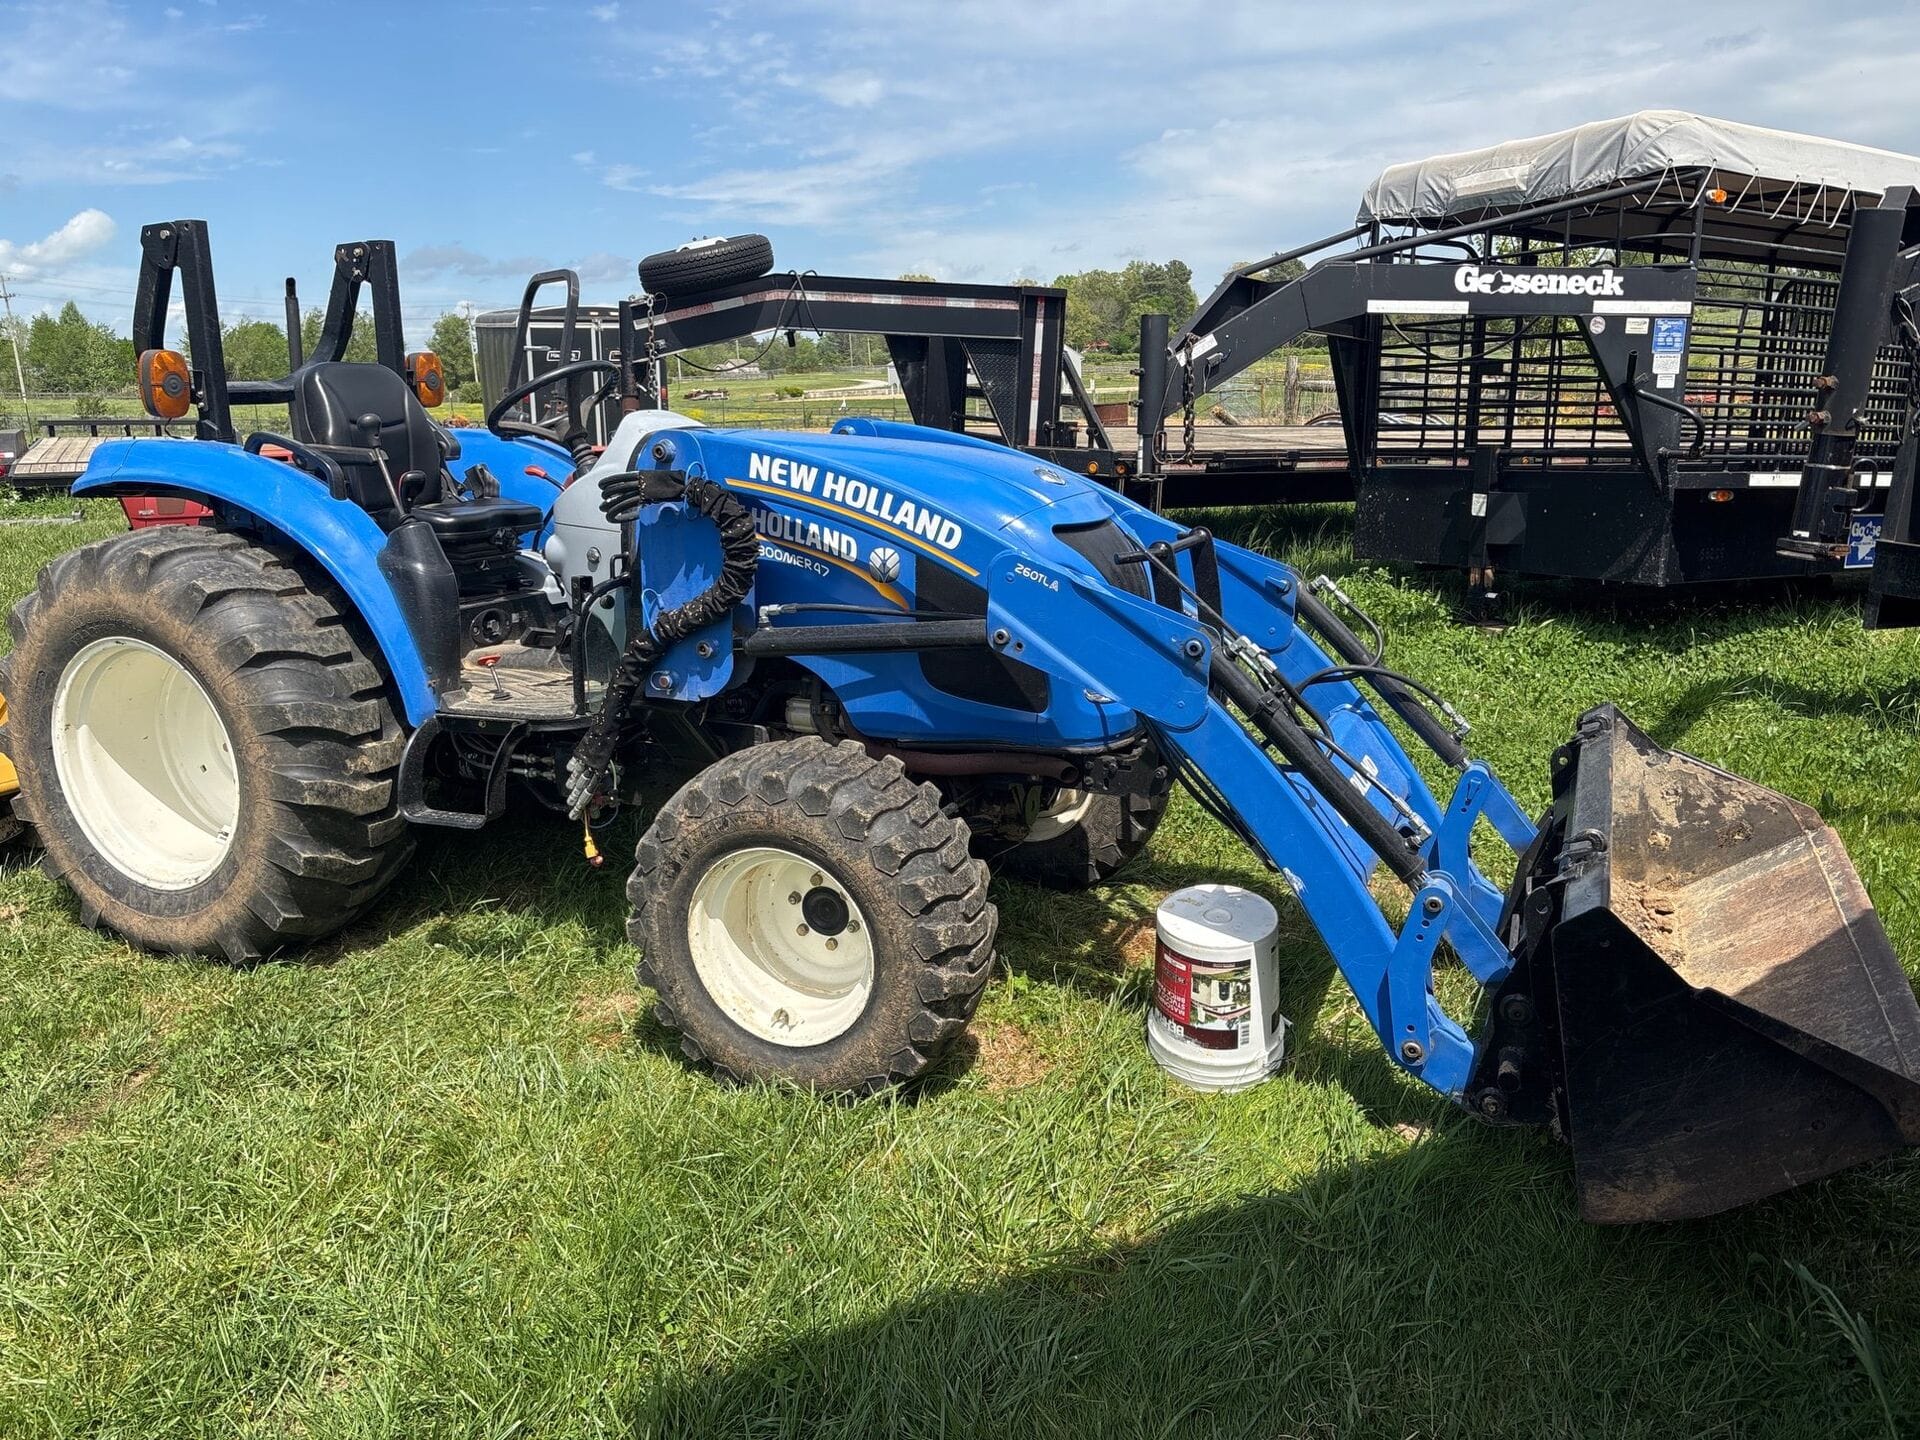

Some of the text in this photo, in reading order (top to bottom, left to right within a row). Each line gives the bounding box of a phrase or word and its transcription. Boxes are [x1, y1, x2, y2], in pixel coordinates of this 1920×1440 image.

[1454, 266, 1624, 296] Gooseneck
[749, 452, 962, 550] NEW HOLLAND
[751, 507, 858, 562] HOLLAND
[813, 562, 830, 577] 47
[1014, 562, 1059, 592] 260TLA
